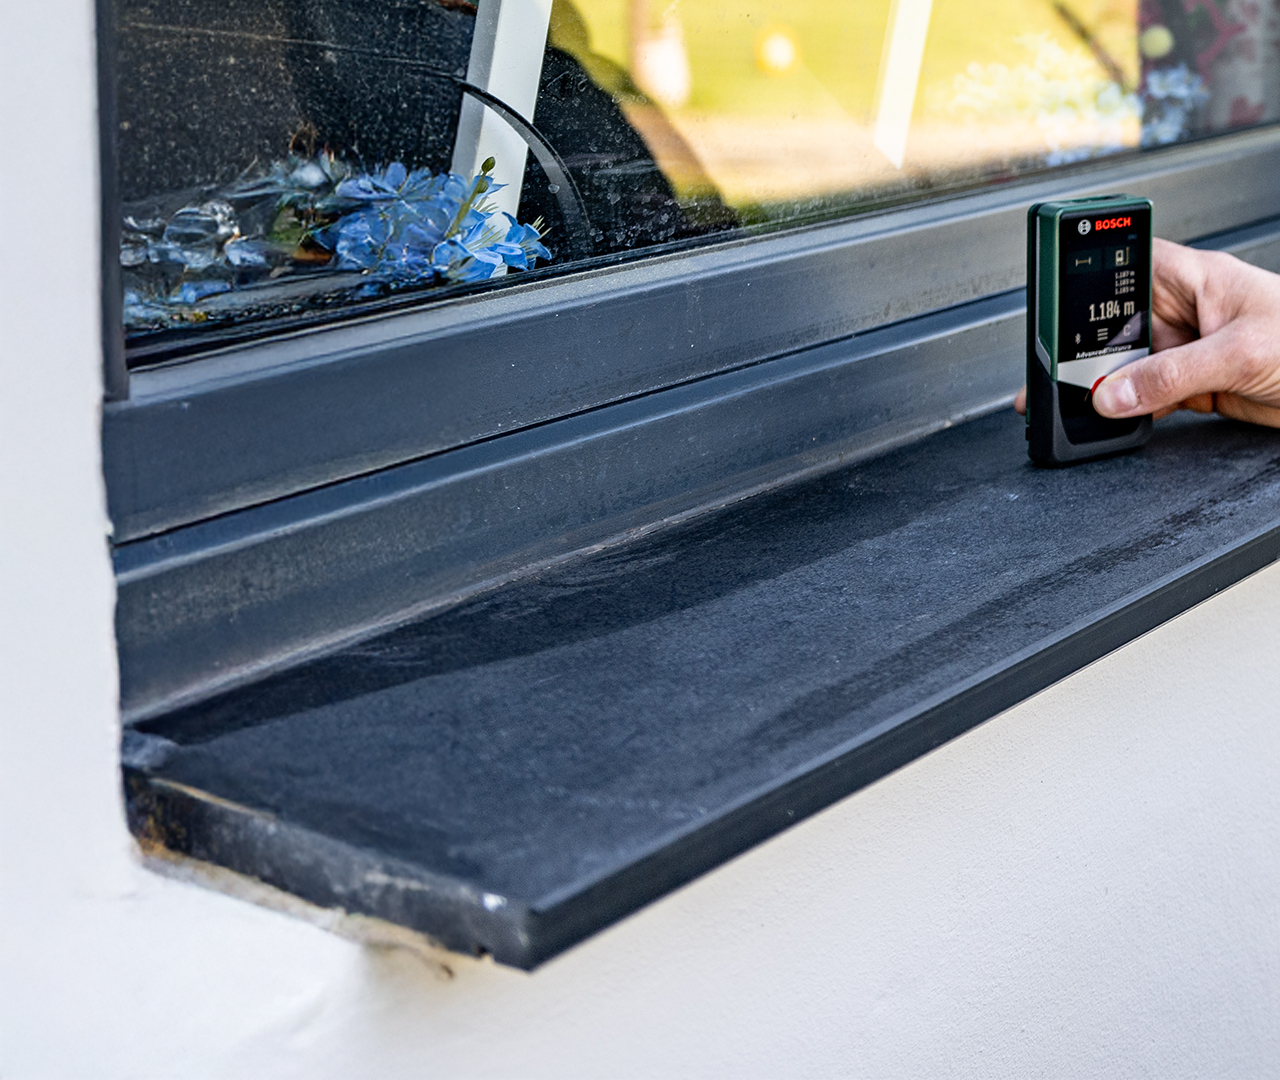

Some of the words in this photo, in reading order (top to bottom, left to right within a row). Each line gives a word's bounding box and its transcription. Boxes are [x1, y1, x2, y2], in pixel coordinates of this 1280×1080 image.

[1095, 217, 1132, 231] BOSCH
[1089, 300, 1120, 322] 1.184
[1124, 301, 1135, 316] m
